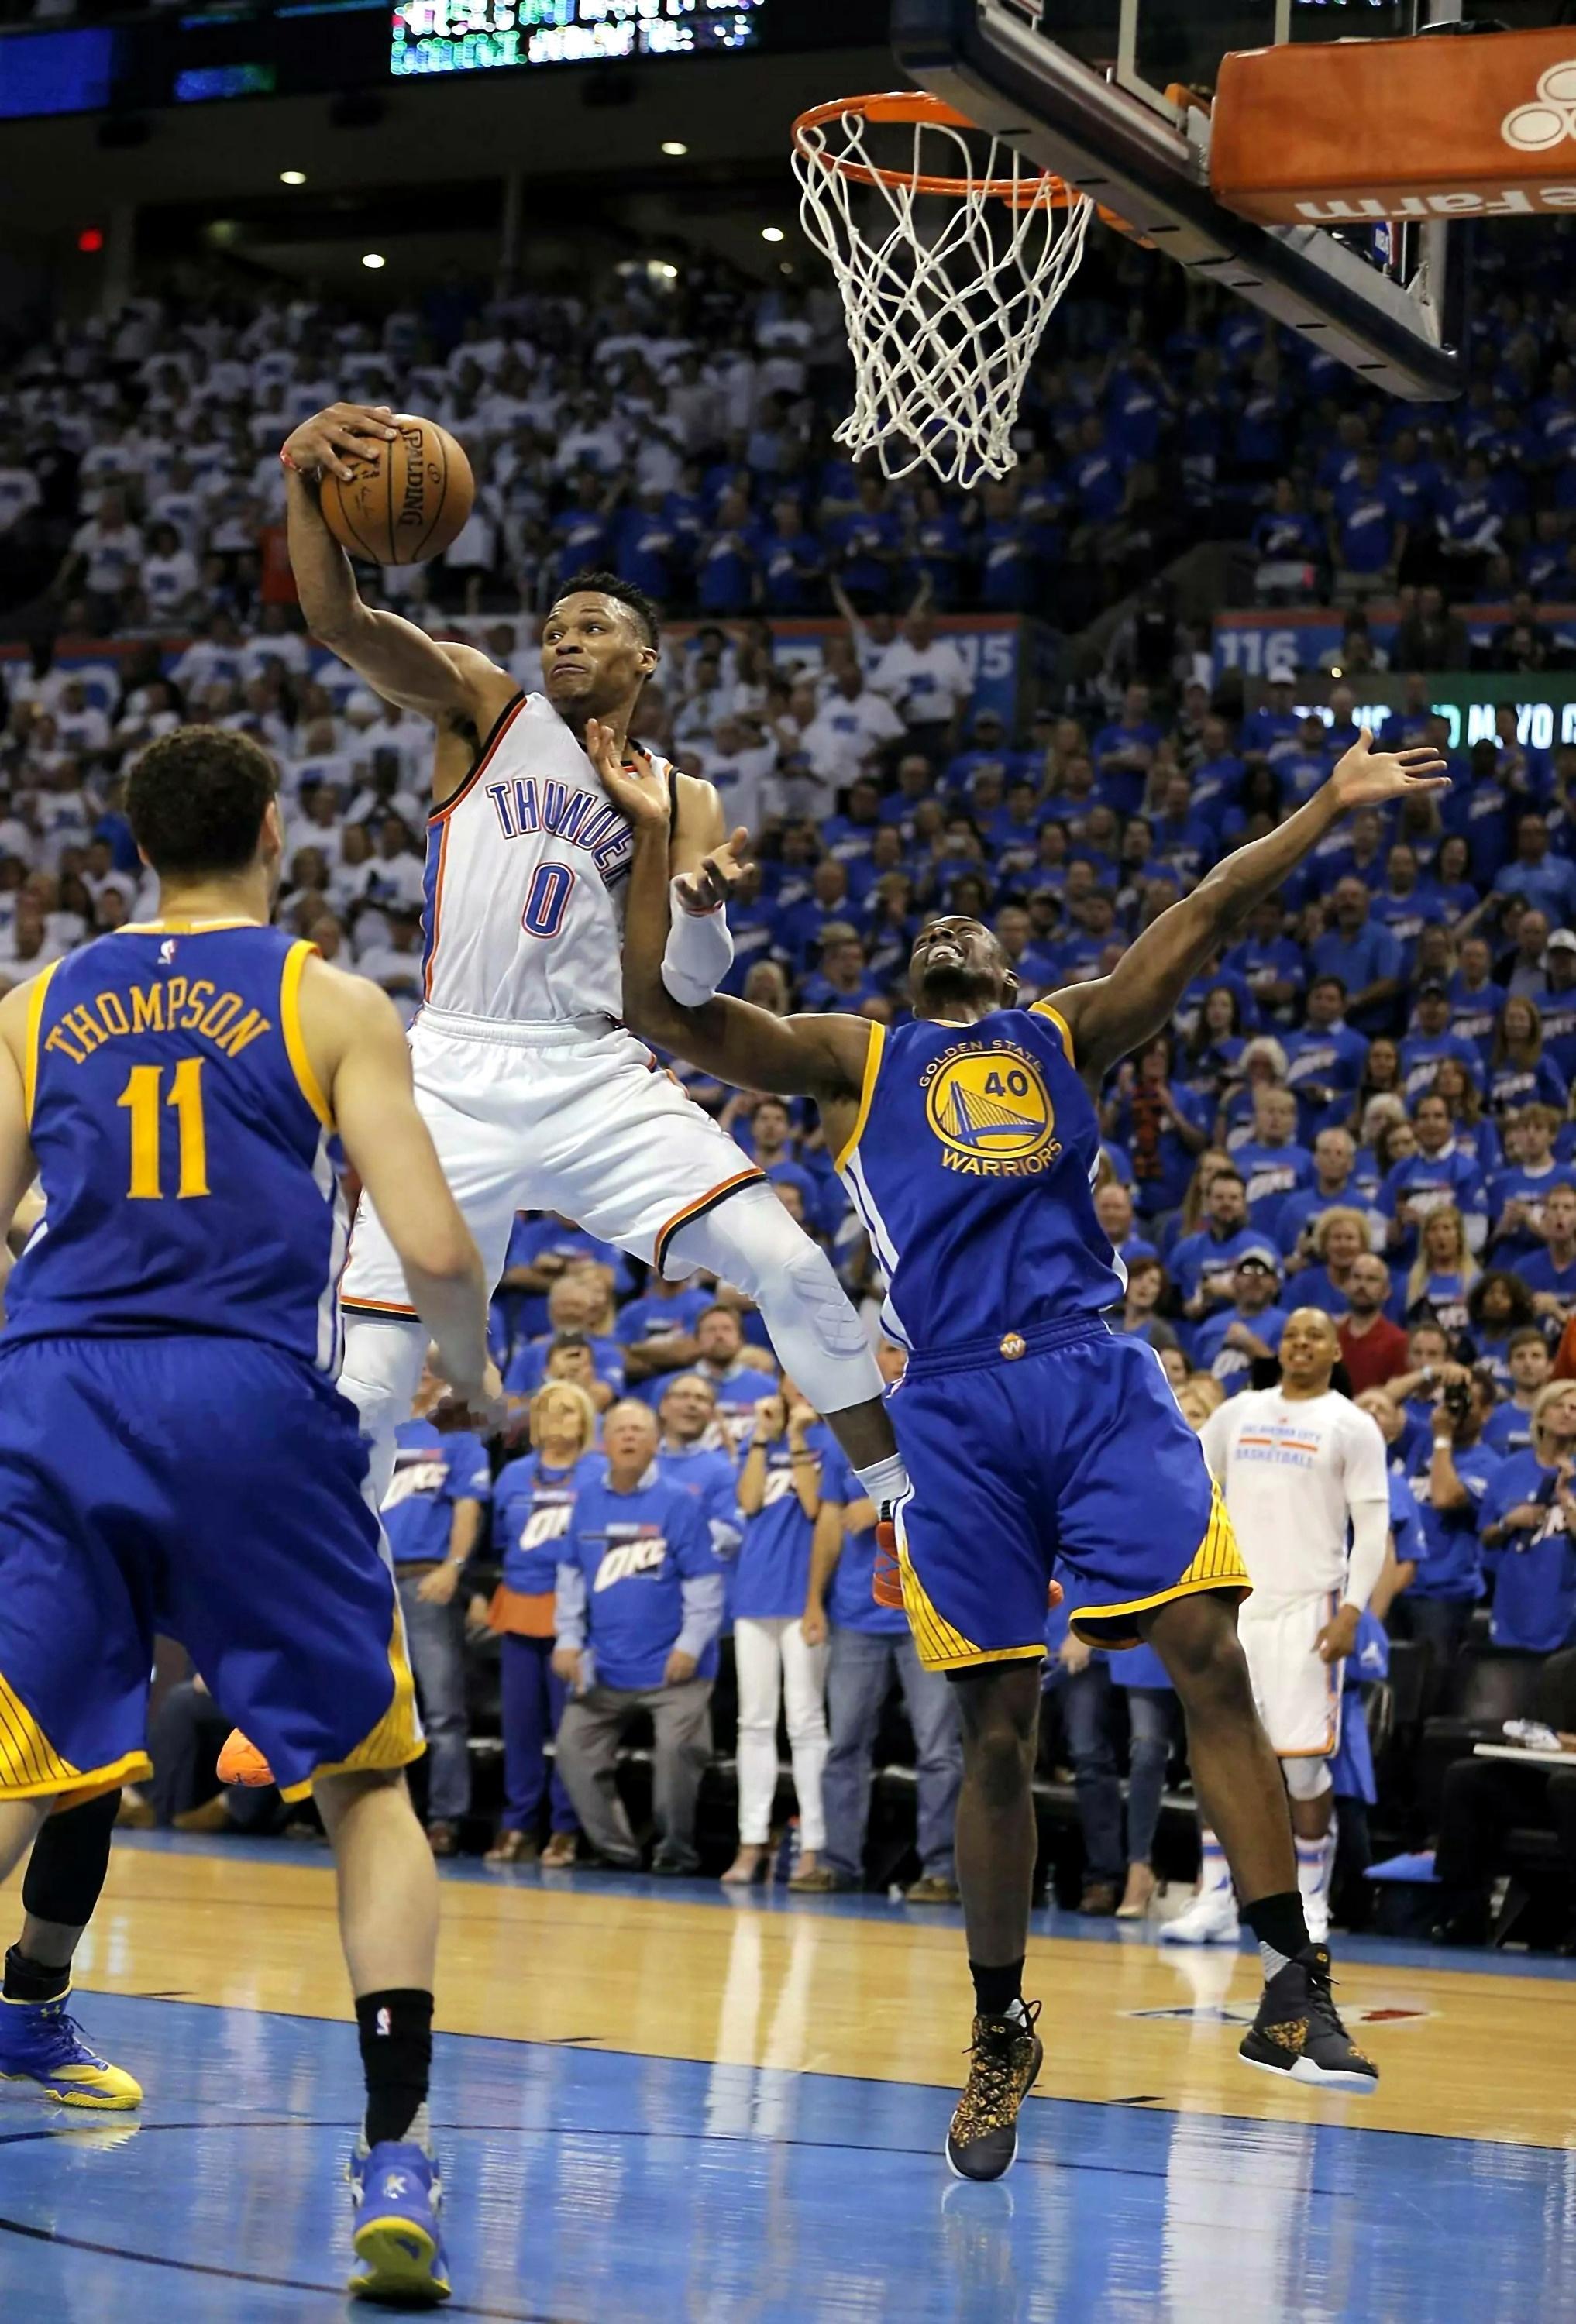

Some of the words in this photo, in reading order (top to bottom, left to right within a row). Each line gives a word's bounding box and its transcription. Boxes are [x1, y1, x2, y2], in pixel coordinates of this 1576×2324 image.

[1295, 191, 1534, 218] Farm
[398, 427, 423, 526] SPALDING
[1218, 632, 1299, 676] 116
[1468, 703, 1554, 749] MYO
[521, 861, 576, 940] 0
[44, 976, 273, 1064] THOMPSON
[919, 1040, 982, 1088] GOLDEN
[991, 1040, 1044, 1073] STATE
[984, 1070, 1029, 1097] 40
[116, 1056, 212, 1200] 11
[940, 1137, 1063, 1177] WARRIORS
[991, 2025, 1006, 2034] 40
